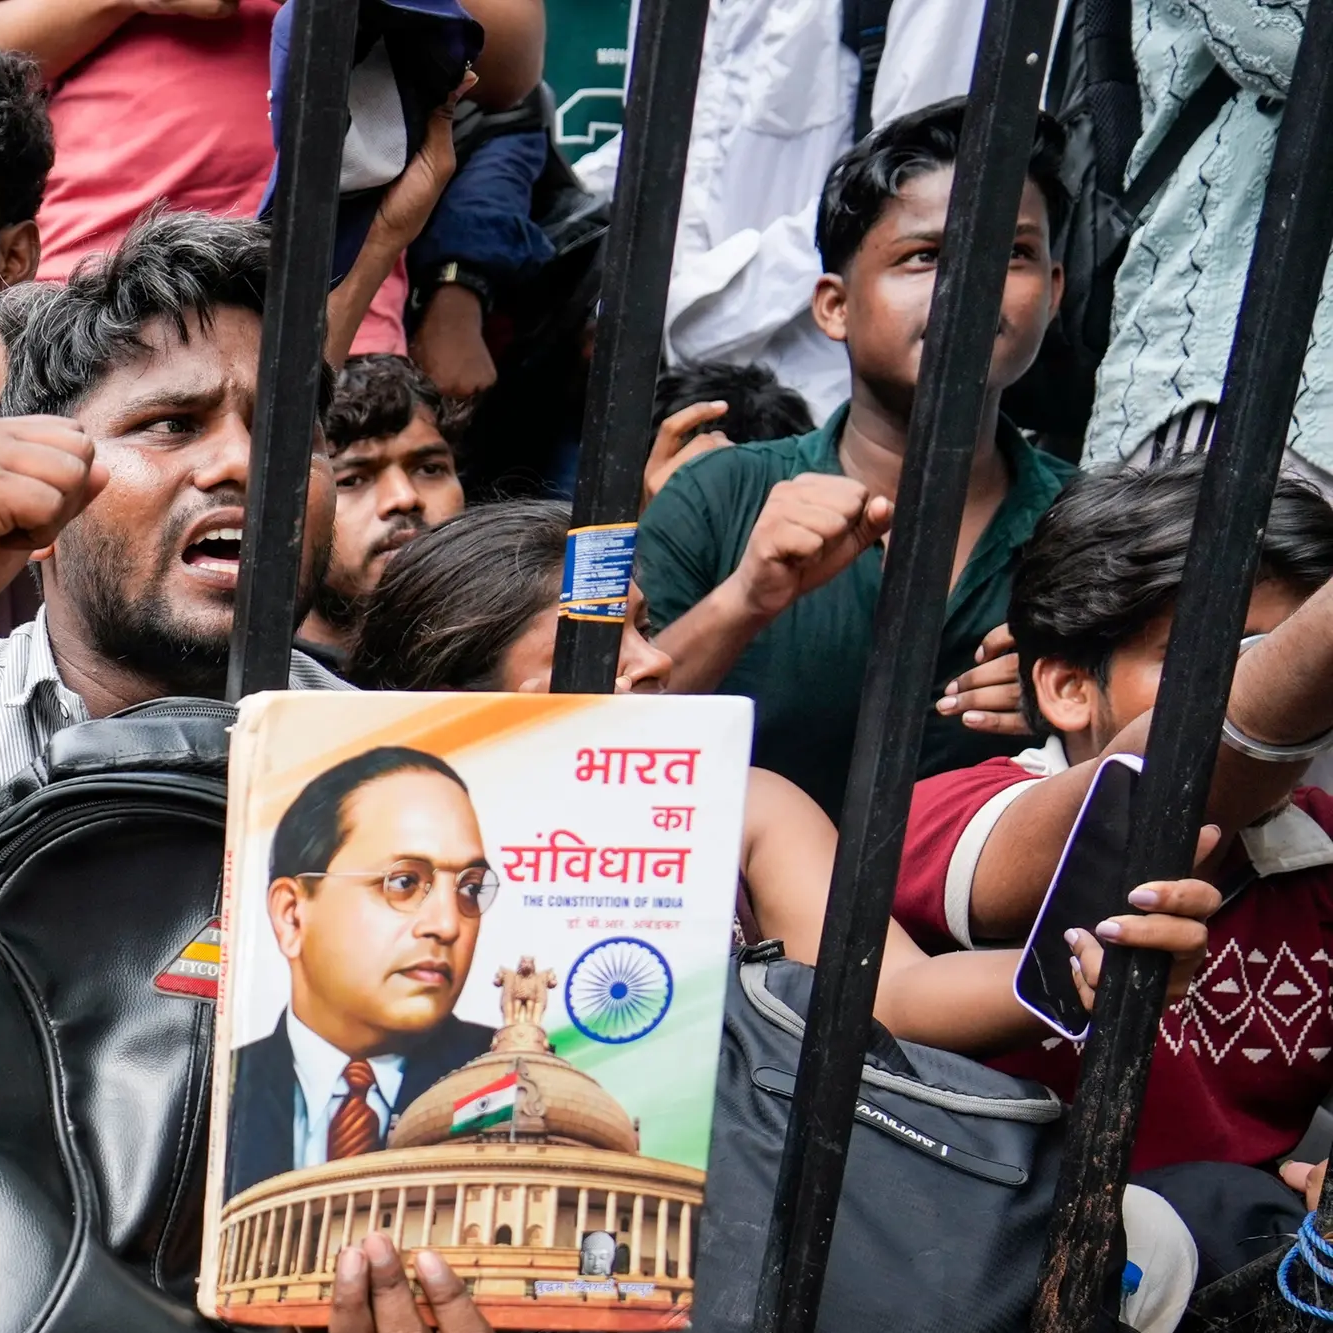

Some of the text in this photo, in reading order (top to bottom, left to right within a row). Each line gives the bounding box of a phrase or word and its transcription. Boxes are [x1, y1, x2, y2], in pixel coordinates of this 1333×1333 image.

[576, 747, 702, 786] भारत
[652, 805, 695, 833] का
[501, 829, 692, 885] संविधान
[523, 895, 683, 908] THE CONSTITUTION OF INDIA
[179, 960, 218, 976] TYCO
